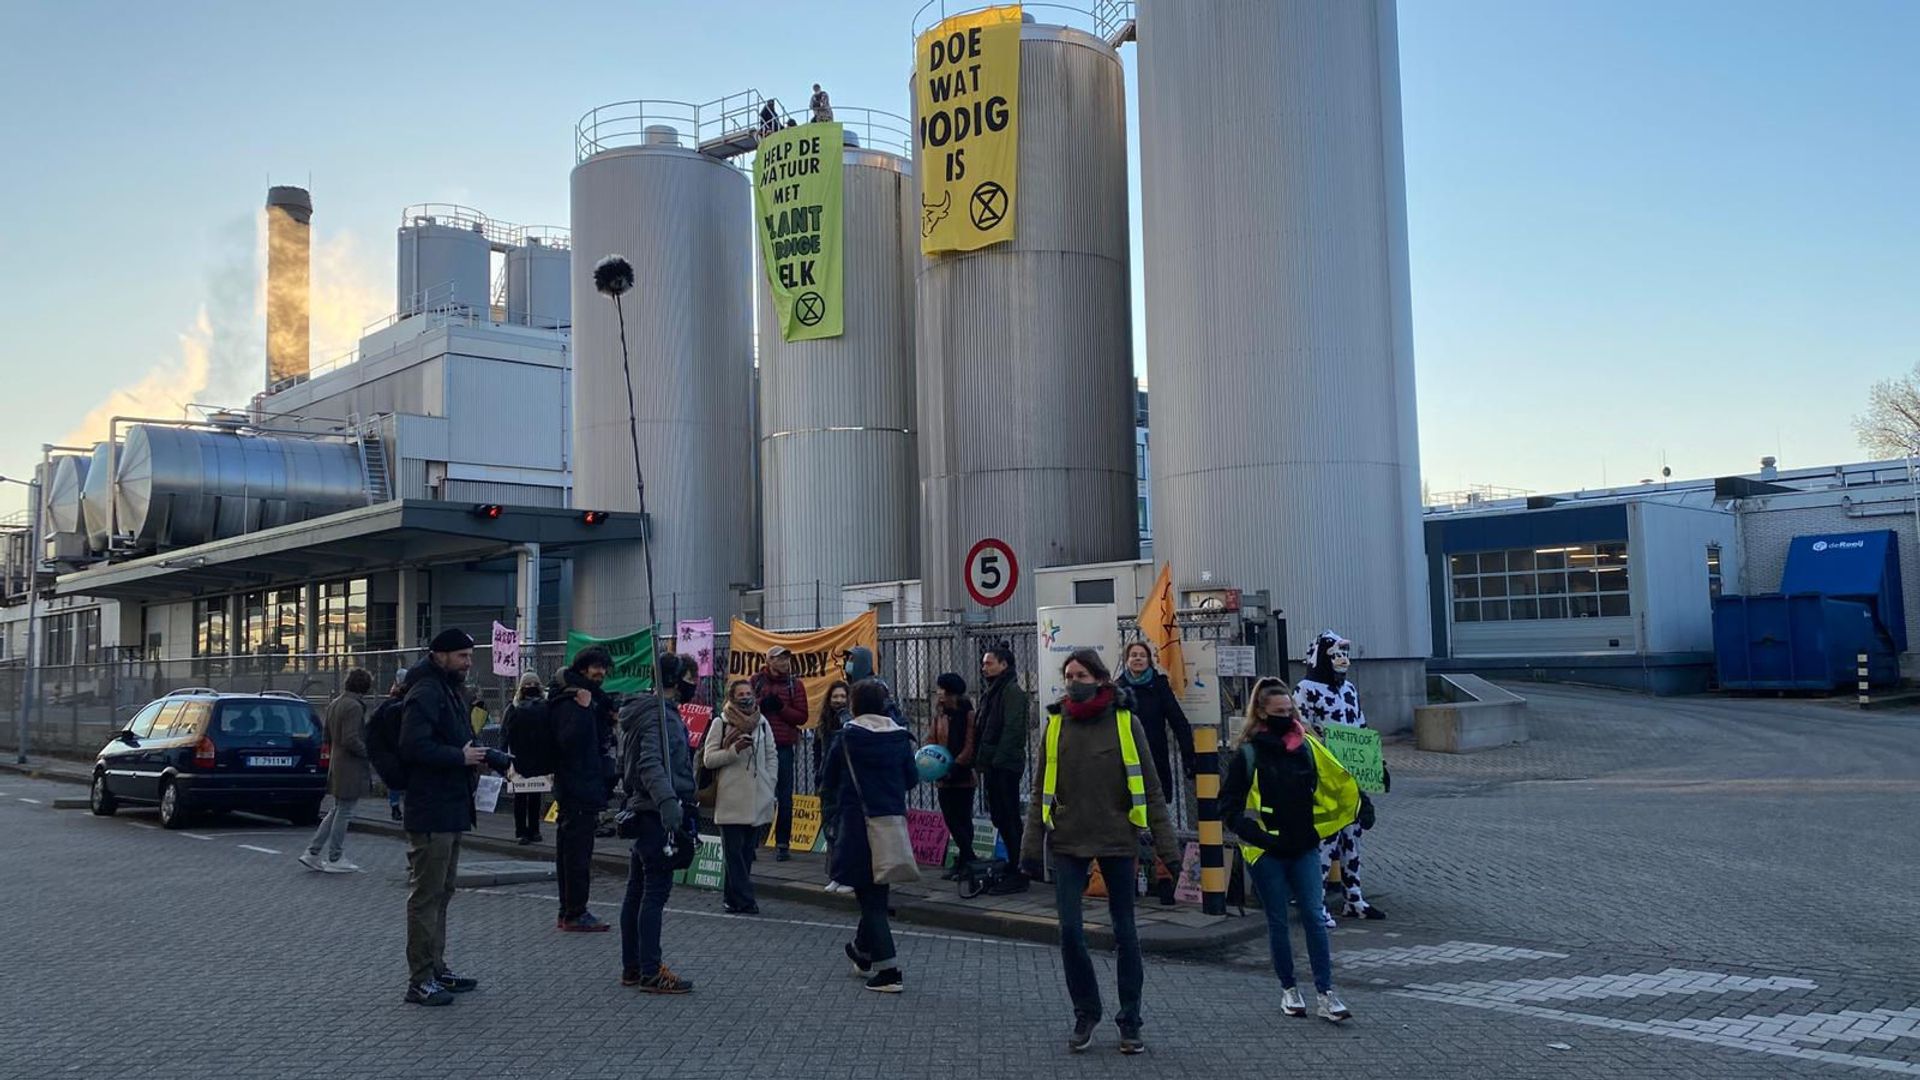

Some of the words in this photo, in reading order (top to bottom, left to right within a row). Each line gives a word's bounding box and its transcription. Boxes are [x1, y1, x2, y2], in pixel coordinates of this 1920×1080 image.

[930, 27, 982, 72] DOE
[930, 64, 981, 103] WAT
[764, 142, 792, 168] HELP
[799, 137, 820, 155] DE
[946, 149, 965, 182] IS
[773, 184, 800, 204] MET
[778, 260, 816, 288] ELK
[981, 556, 1001, 589] 5
[1342, 747, 1365, 764] KIES
